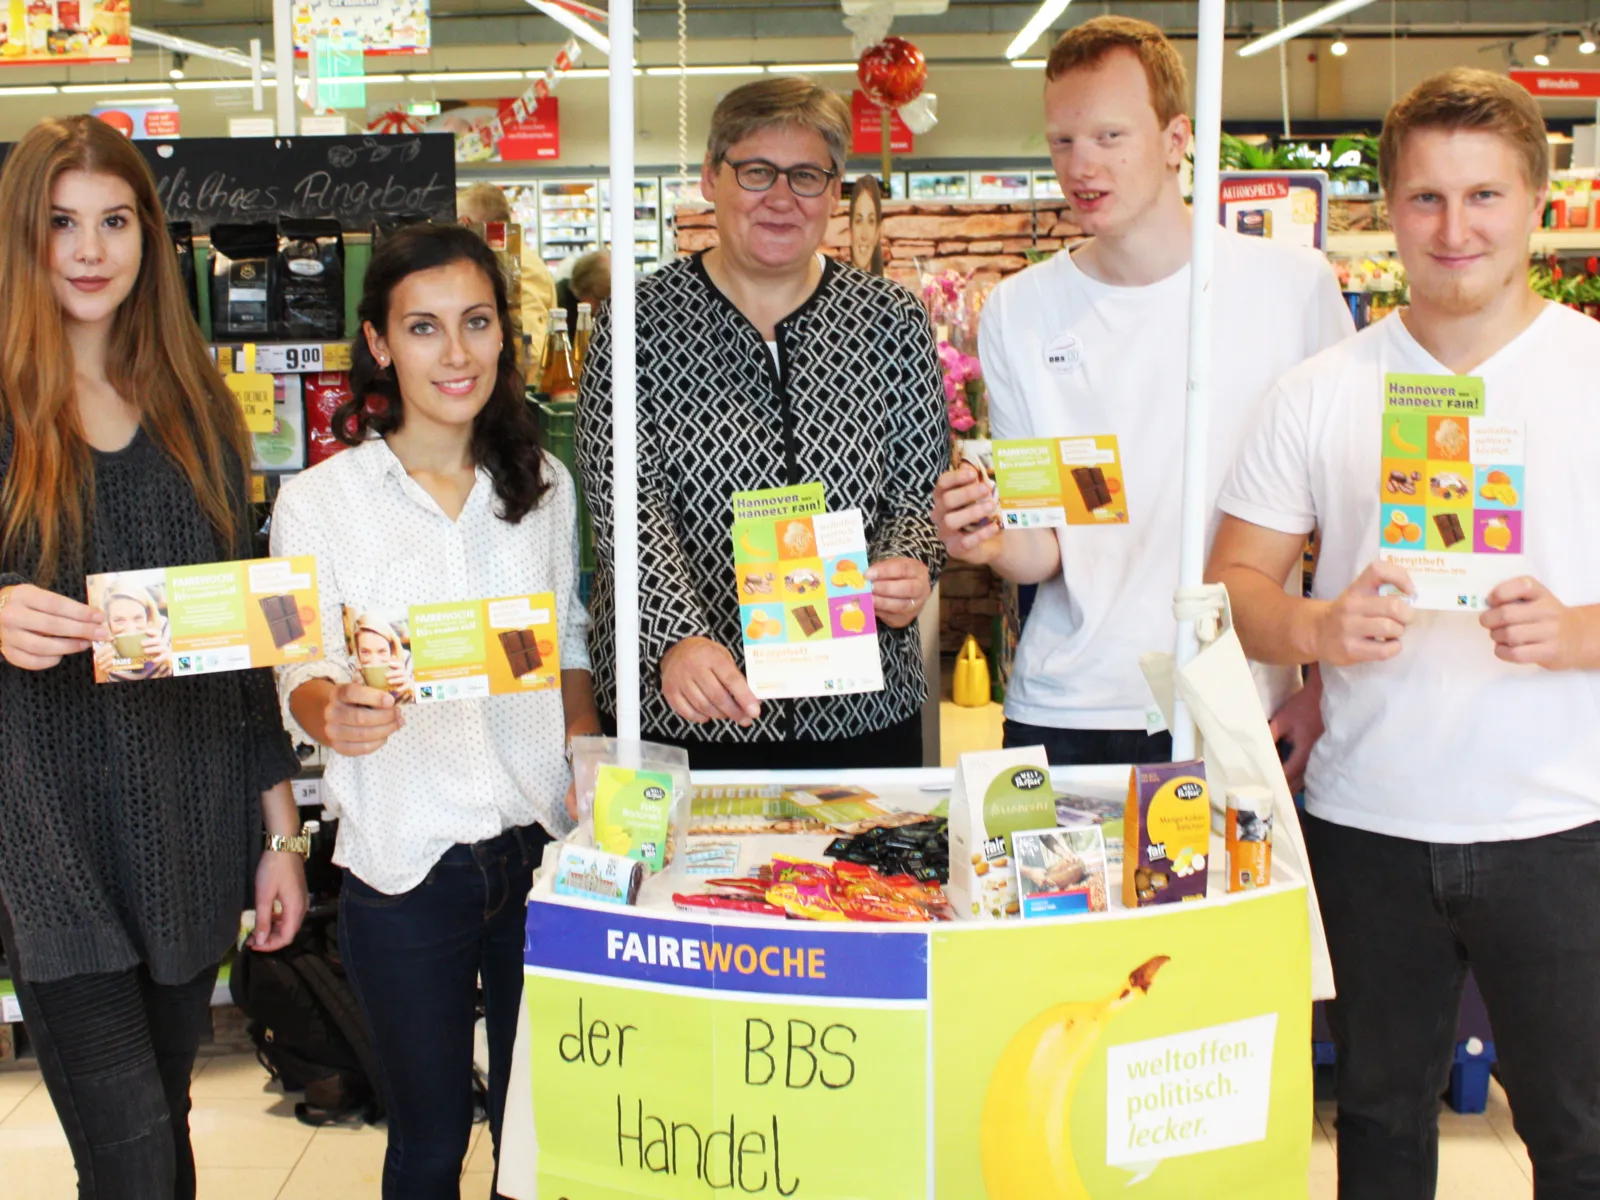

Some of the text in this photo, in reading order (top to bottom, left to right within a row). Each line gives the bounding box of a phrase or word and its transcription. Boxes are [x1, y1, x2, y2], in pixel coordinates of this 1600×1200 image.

[294, 171, 447, 212] Angebot
[1389, 382, 1456, 397] Hannover
[737, 494, 800, 509] Hannover
[984, 836, 1005, 857] fair
[1147, 842, 1166, 858] fair
[606, 929, 827, 979] FAIREWOCHE
[558, 997, 857, 1089] der BBS
[1126, 1037, 1255, 1081] weltoffen.
[1126, 1072, 1240, 1119] politisch.
[616, 1094, 800, 1196] Handel
[1128, 1115, 1208, 1150] lecker.
